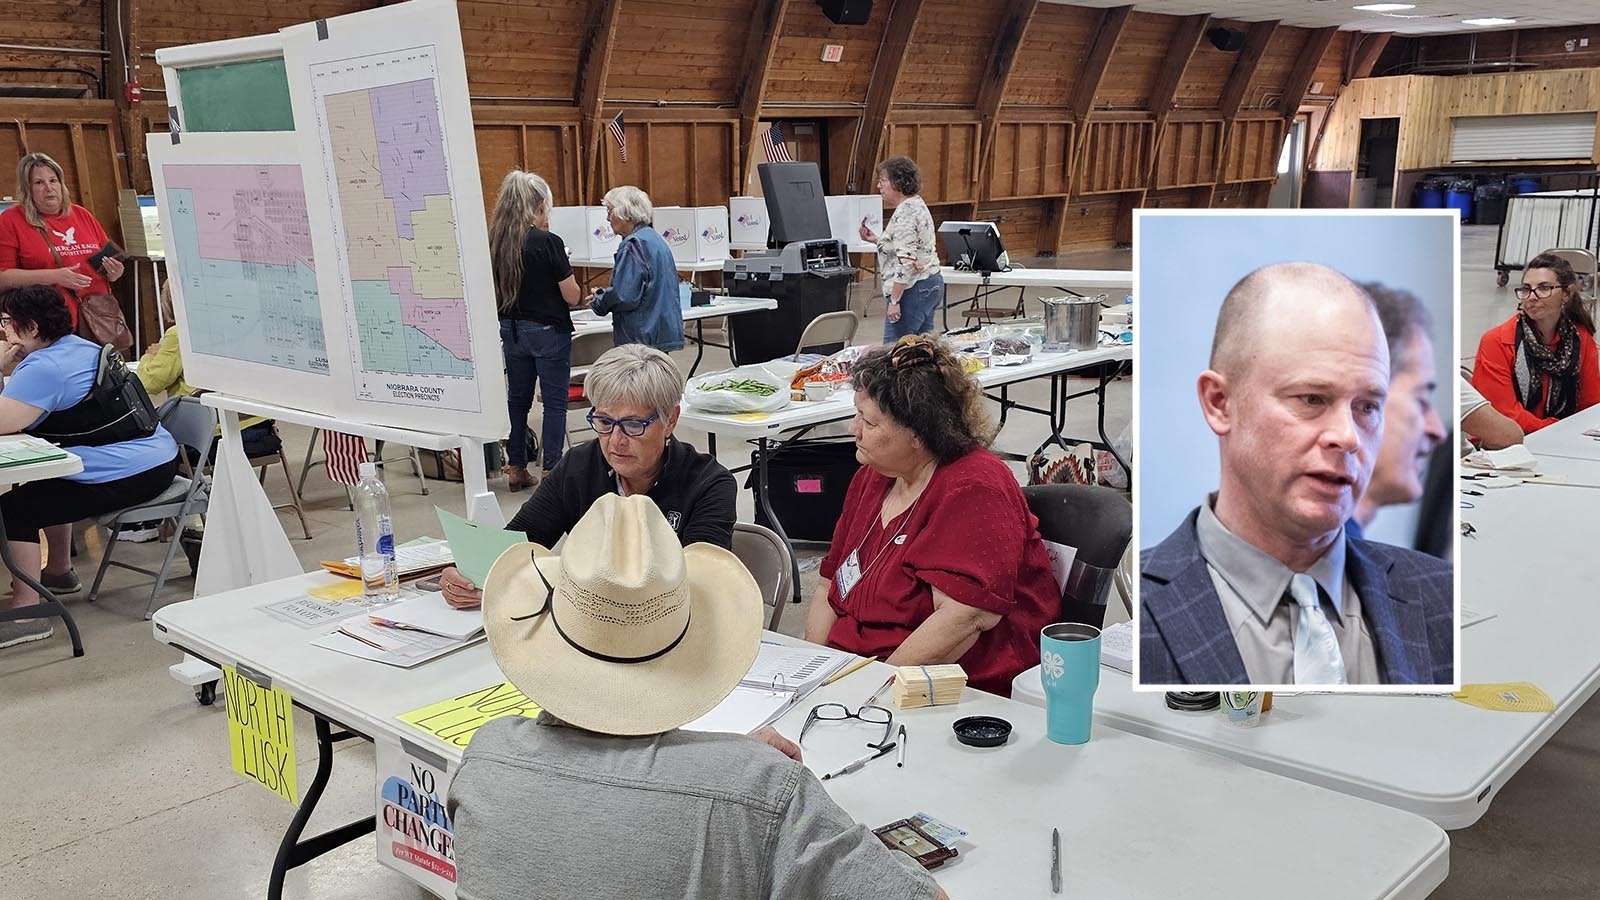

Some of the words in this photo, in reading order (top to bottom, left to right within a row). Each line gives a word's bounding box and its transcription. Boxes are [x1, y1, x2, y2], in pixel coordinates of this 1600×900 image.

[386, 383, 419, 392] NIOBRARA
[420, 386, 445, 395] COUNTY
[393, 391, 415, 399] ELECTION
[415, 392, 441, 402] PRECINCTS
[223, 669, 289, 748] NORTH
[454, 683, 541, 718] NOR
[412, 706, 484, 747] LU
[241, 728, 293, 803] LUSK
[410, 762, 435, 794] NO
